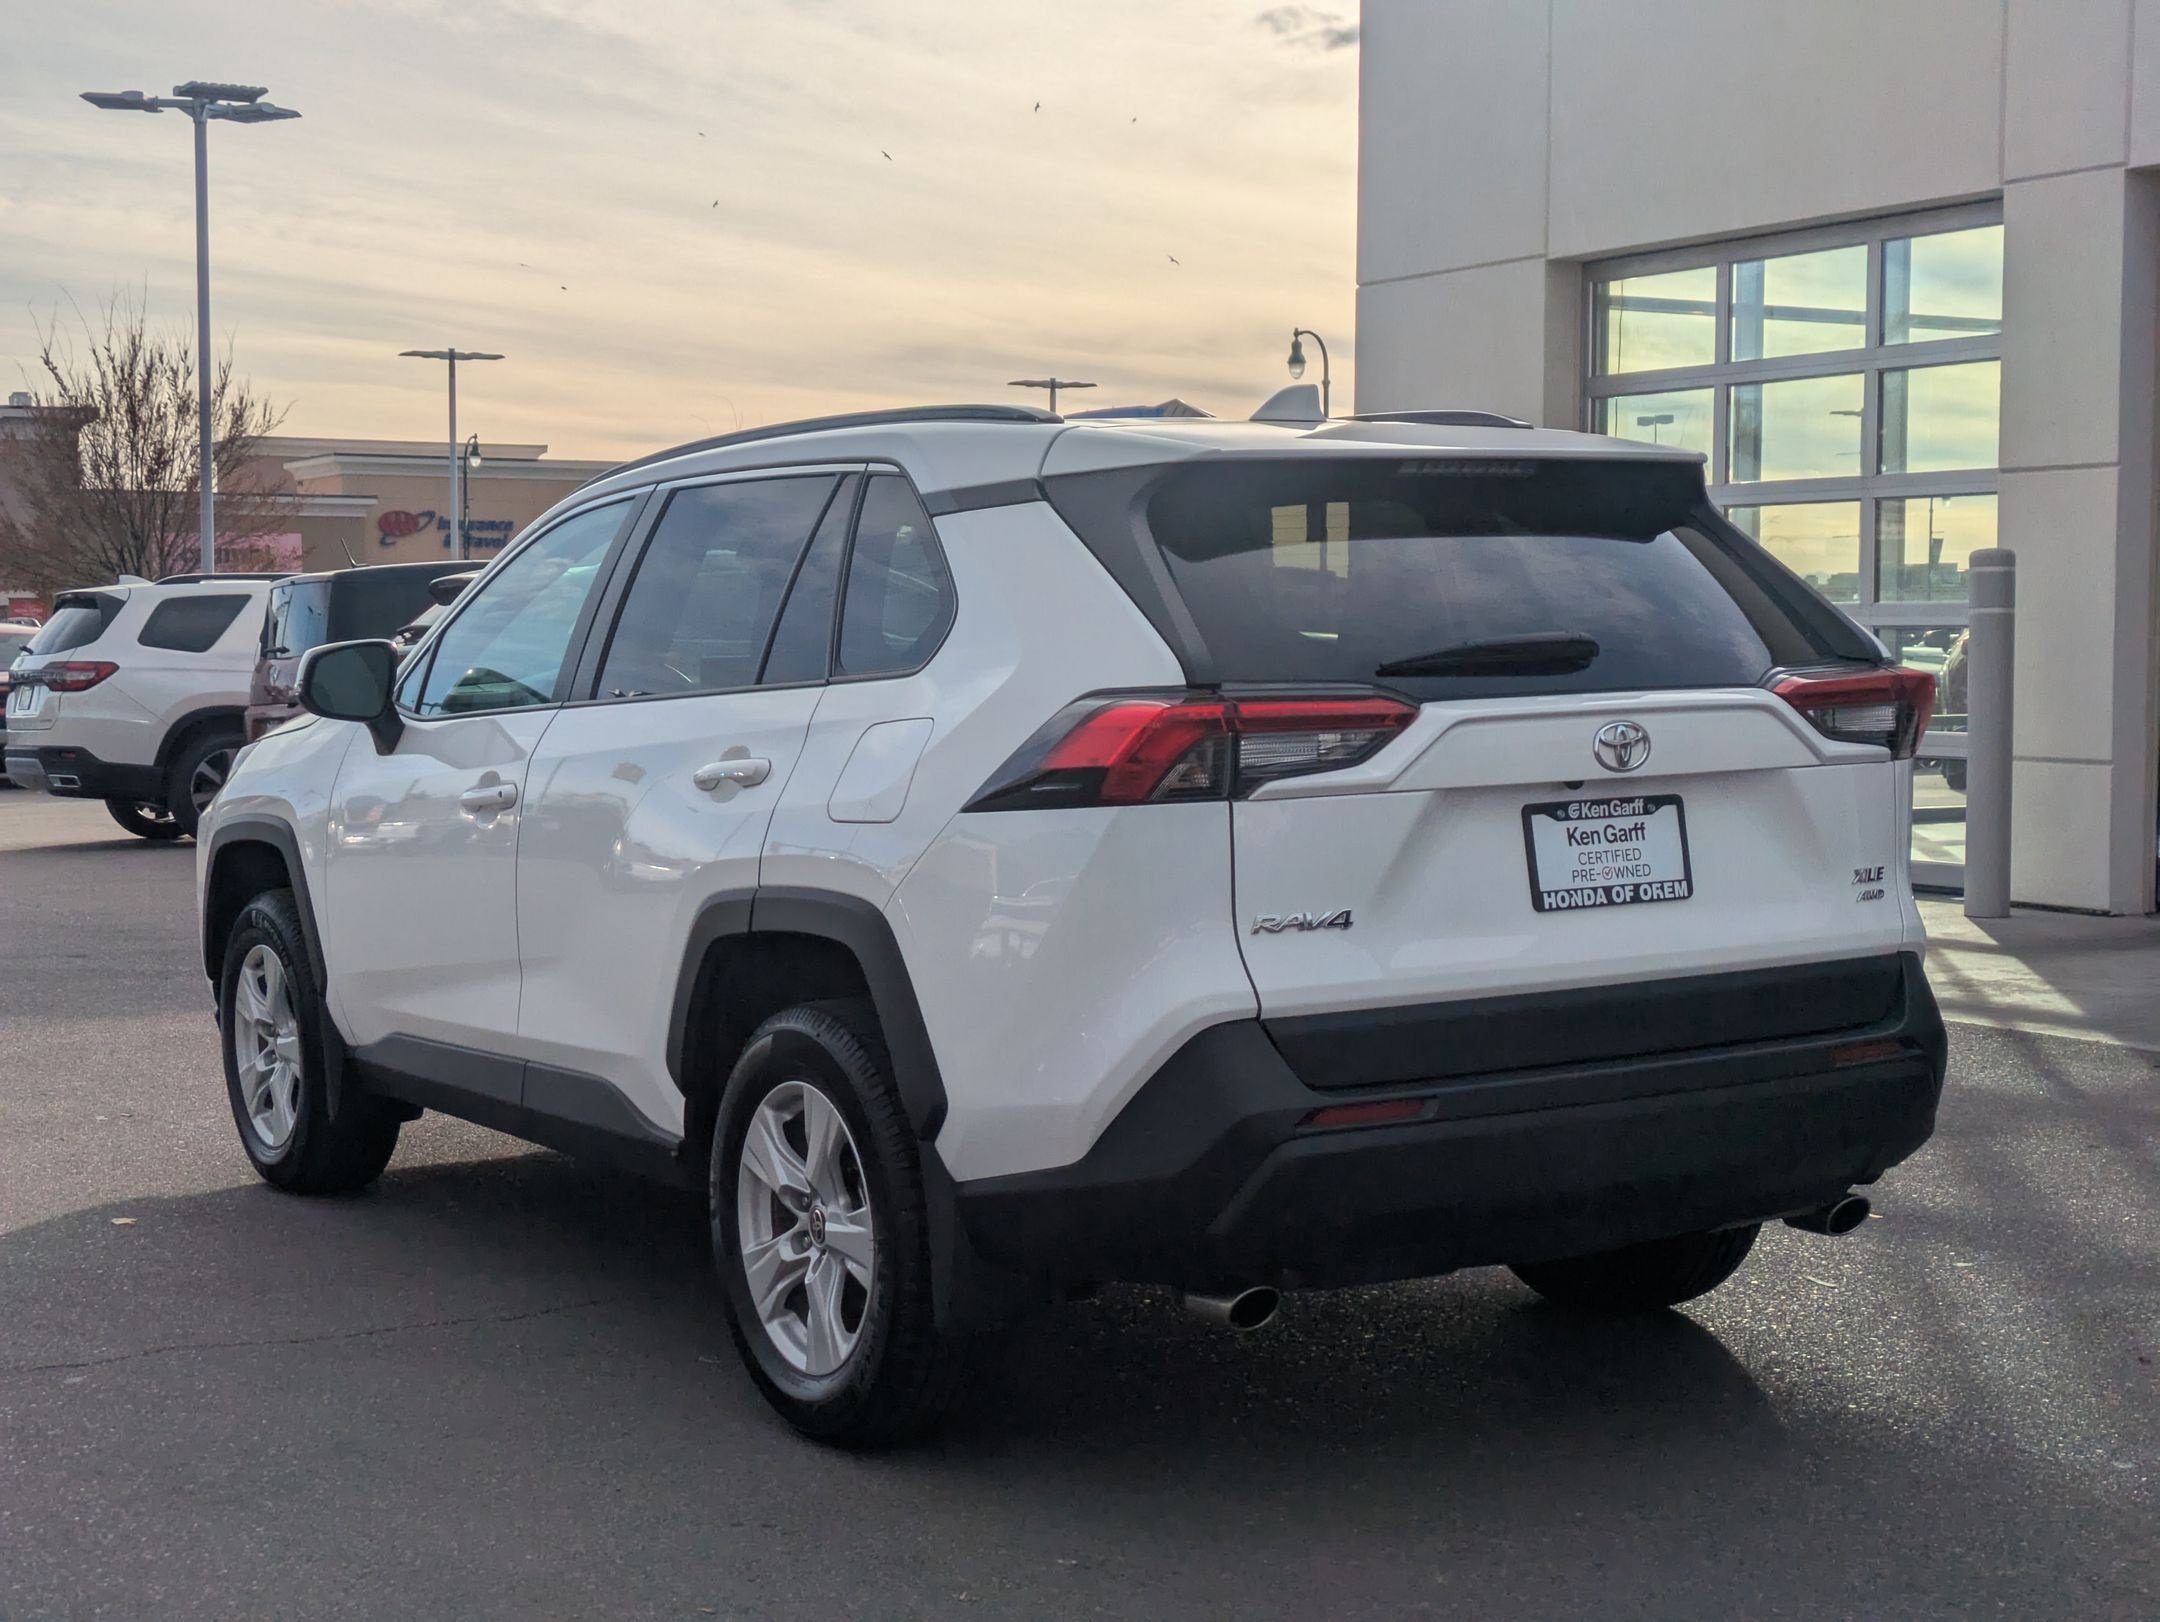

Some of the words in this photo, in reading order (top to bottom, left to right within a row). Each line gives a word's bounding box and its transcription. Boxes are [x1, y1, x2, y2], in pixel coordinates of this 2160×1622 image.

[438, 516, 513, 531] Inrance
[1580, 802, 1609, 818] Ken
[1610, 799, 1645, 816] Garff
[1566, 825, 1600, 847] Ken
[1603, 822, 1646, 843] Garff
[1578, 848, 1642, 866] CERTIFIED
[1543, 887, 1608, 910] HONDA
[1612, 885, 1634, 903] OF
[1640, 880, 1689, 901] OREM
[1251, 908, 1353, 935] RAV4
